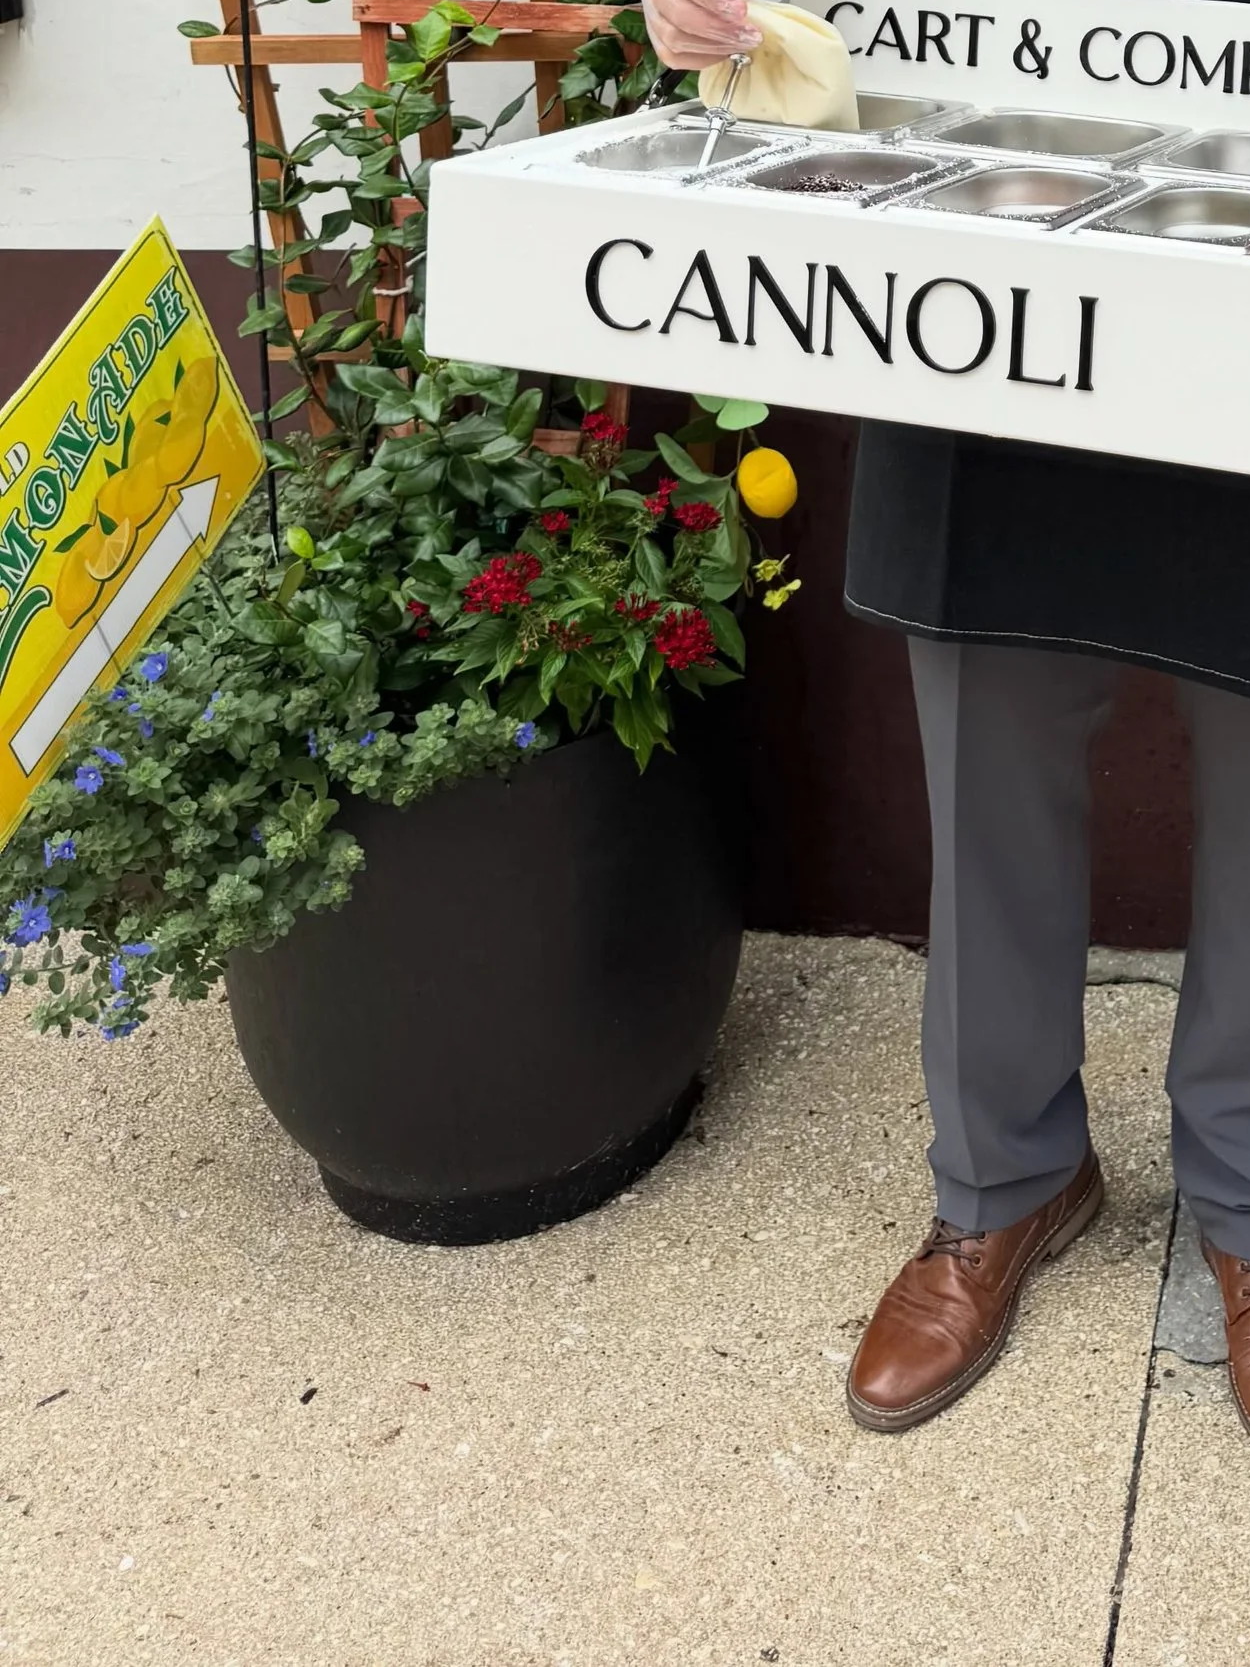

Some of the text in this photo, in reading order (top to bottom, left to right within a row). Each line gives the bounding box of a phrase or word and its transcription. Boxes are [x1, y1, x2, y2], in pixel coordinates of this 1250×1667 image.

[824, 1, 996, 67] CART
[1012, 18, 1053, 80] &
[584, 238, 1100, 391] CANNOLI
[0, 266, 190, 620] MONADE
